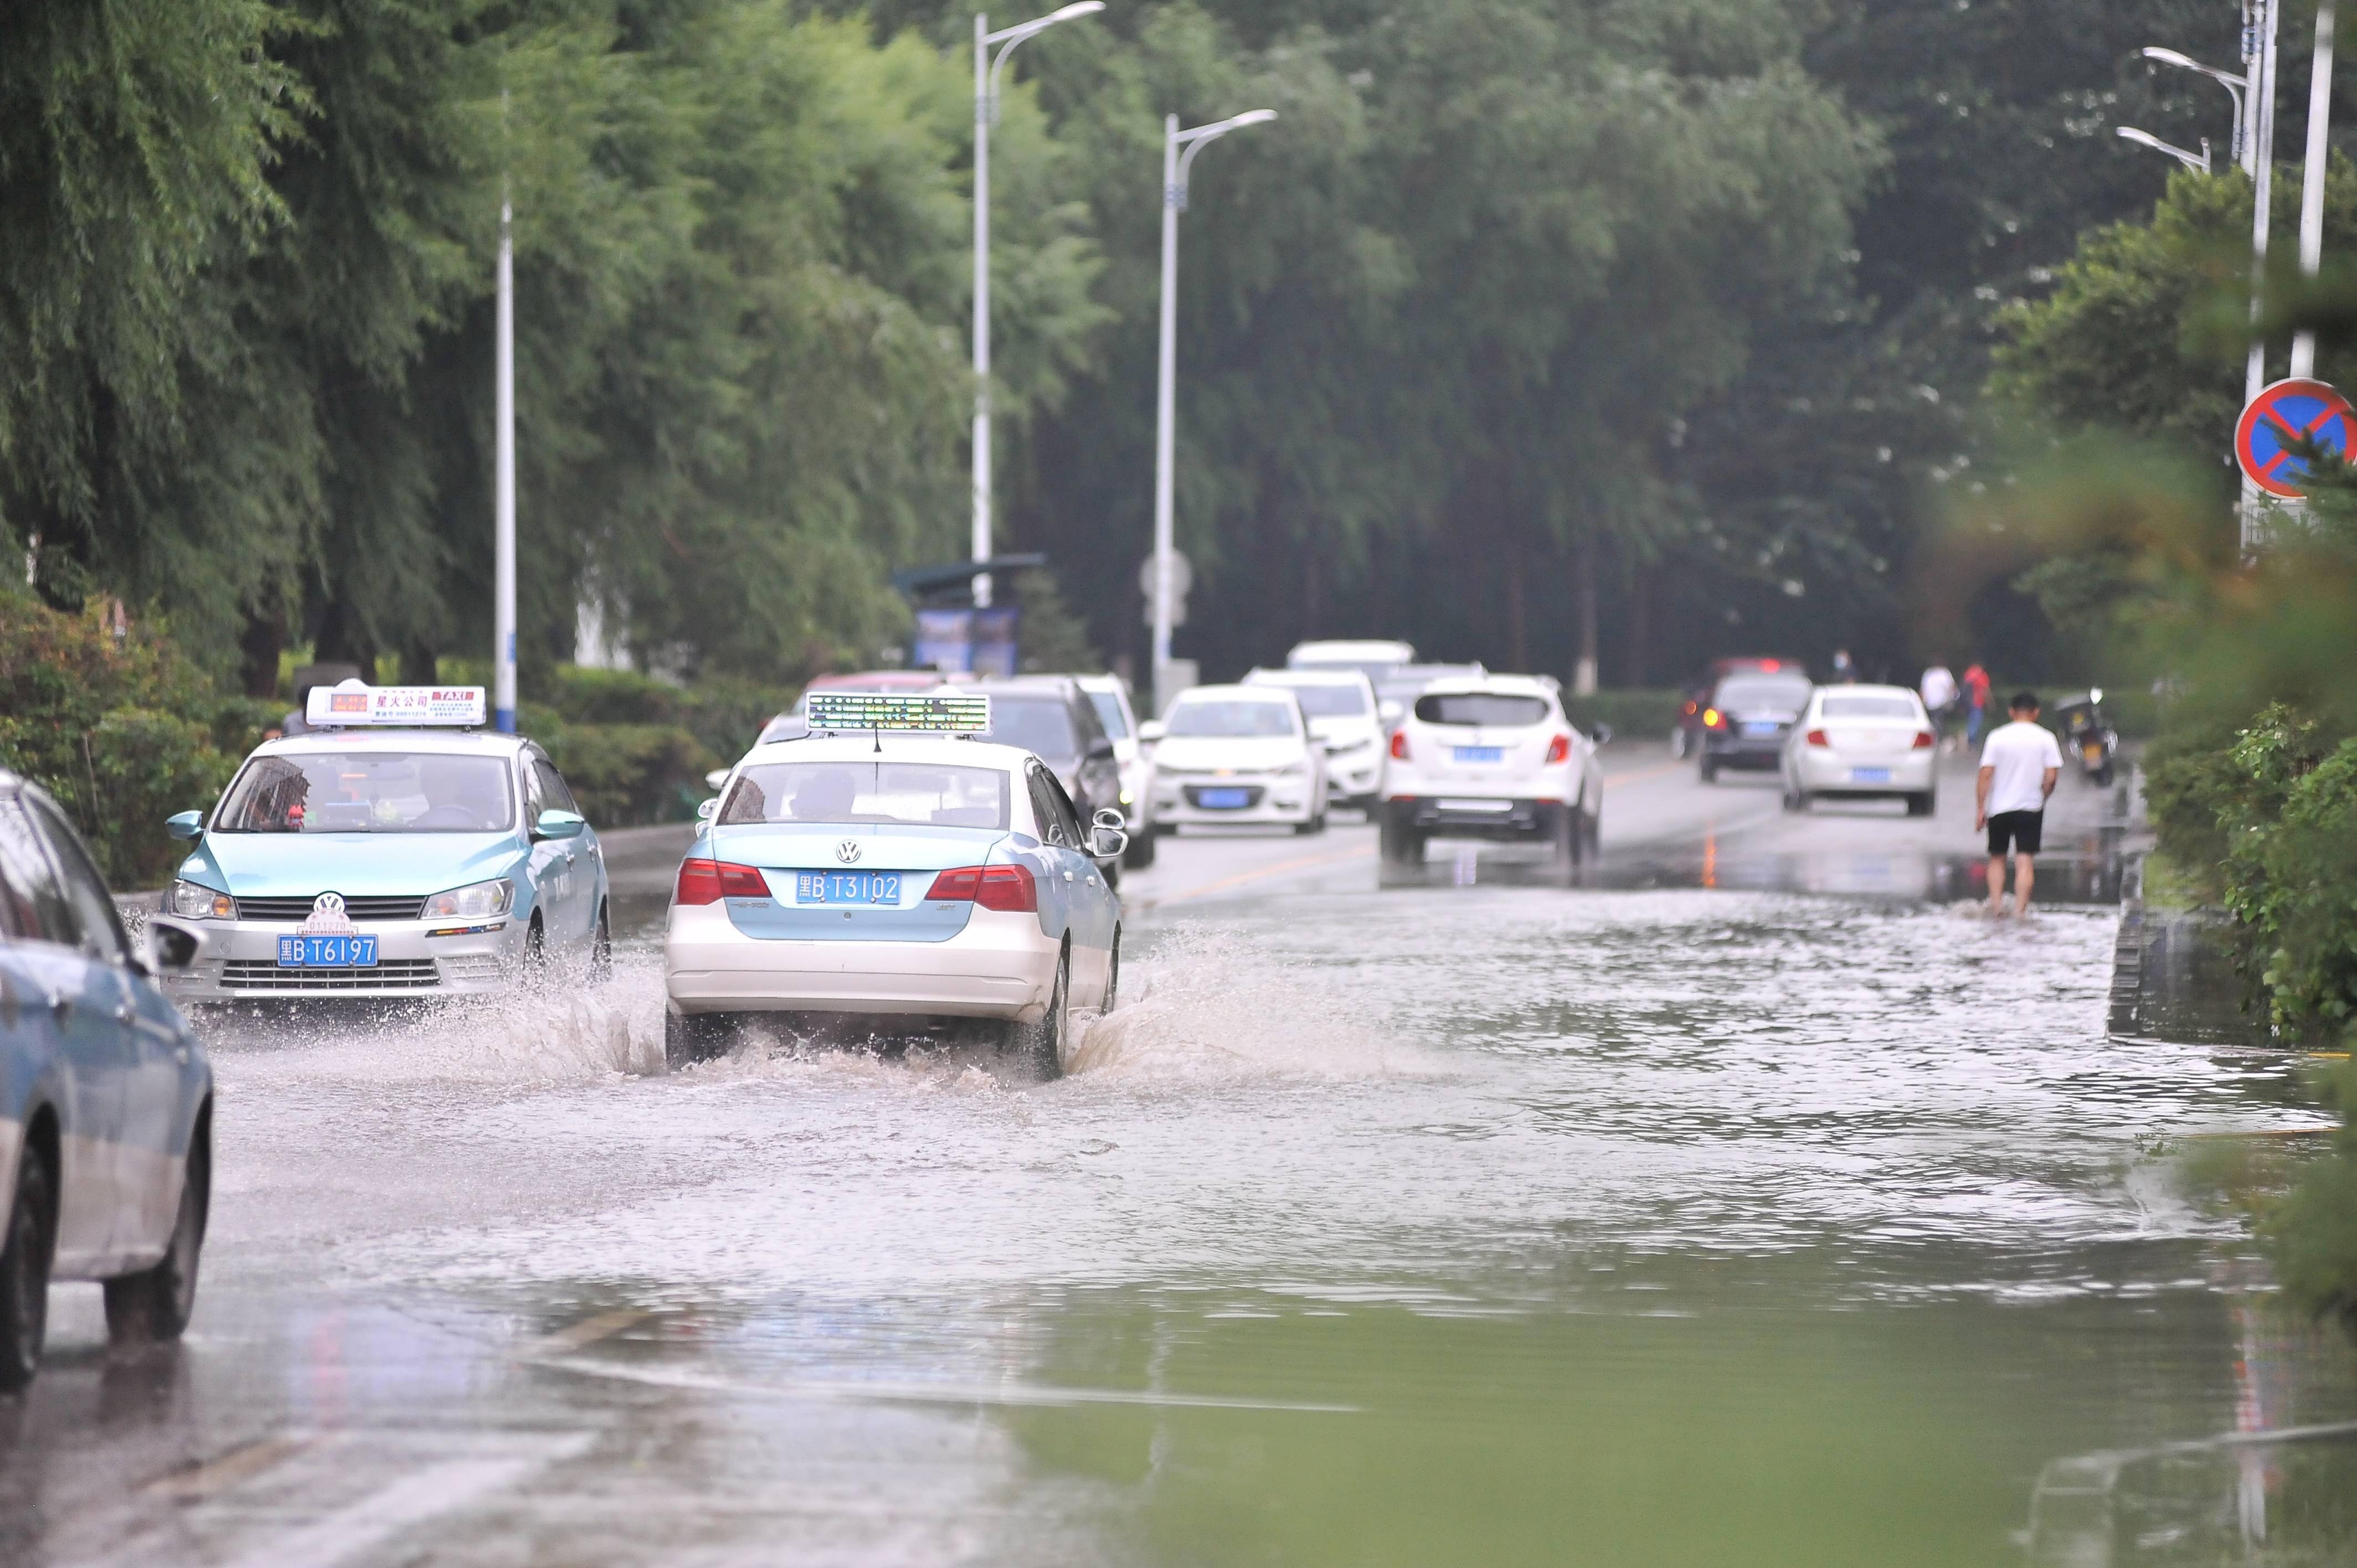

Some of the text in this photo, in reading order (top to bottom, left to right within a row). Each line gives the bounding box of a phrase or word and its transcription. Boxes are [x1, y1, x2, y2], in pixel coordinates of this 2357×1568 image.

[439, 691, 467, 700] TAXI
[376, 695, 428, 708] 星火公司
[310, 922, 346, 930] 011270
